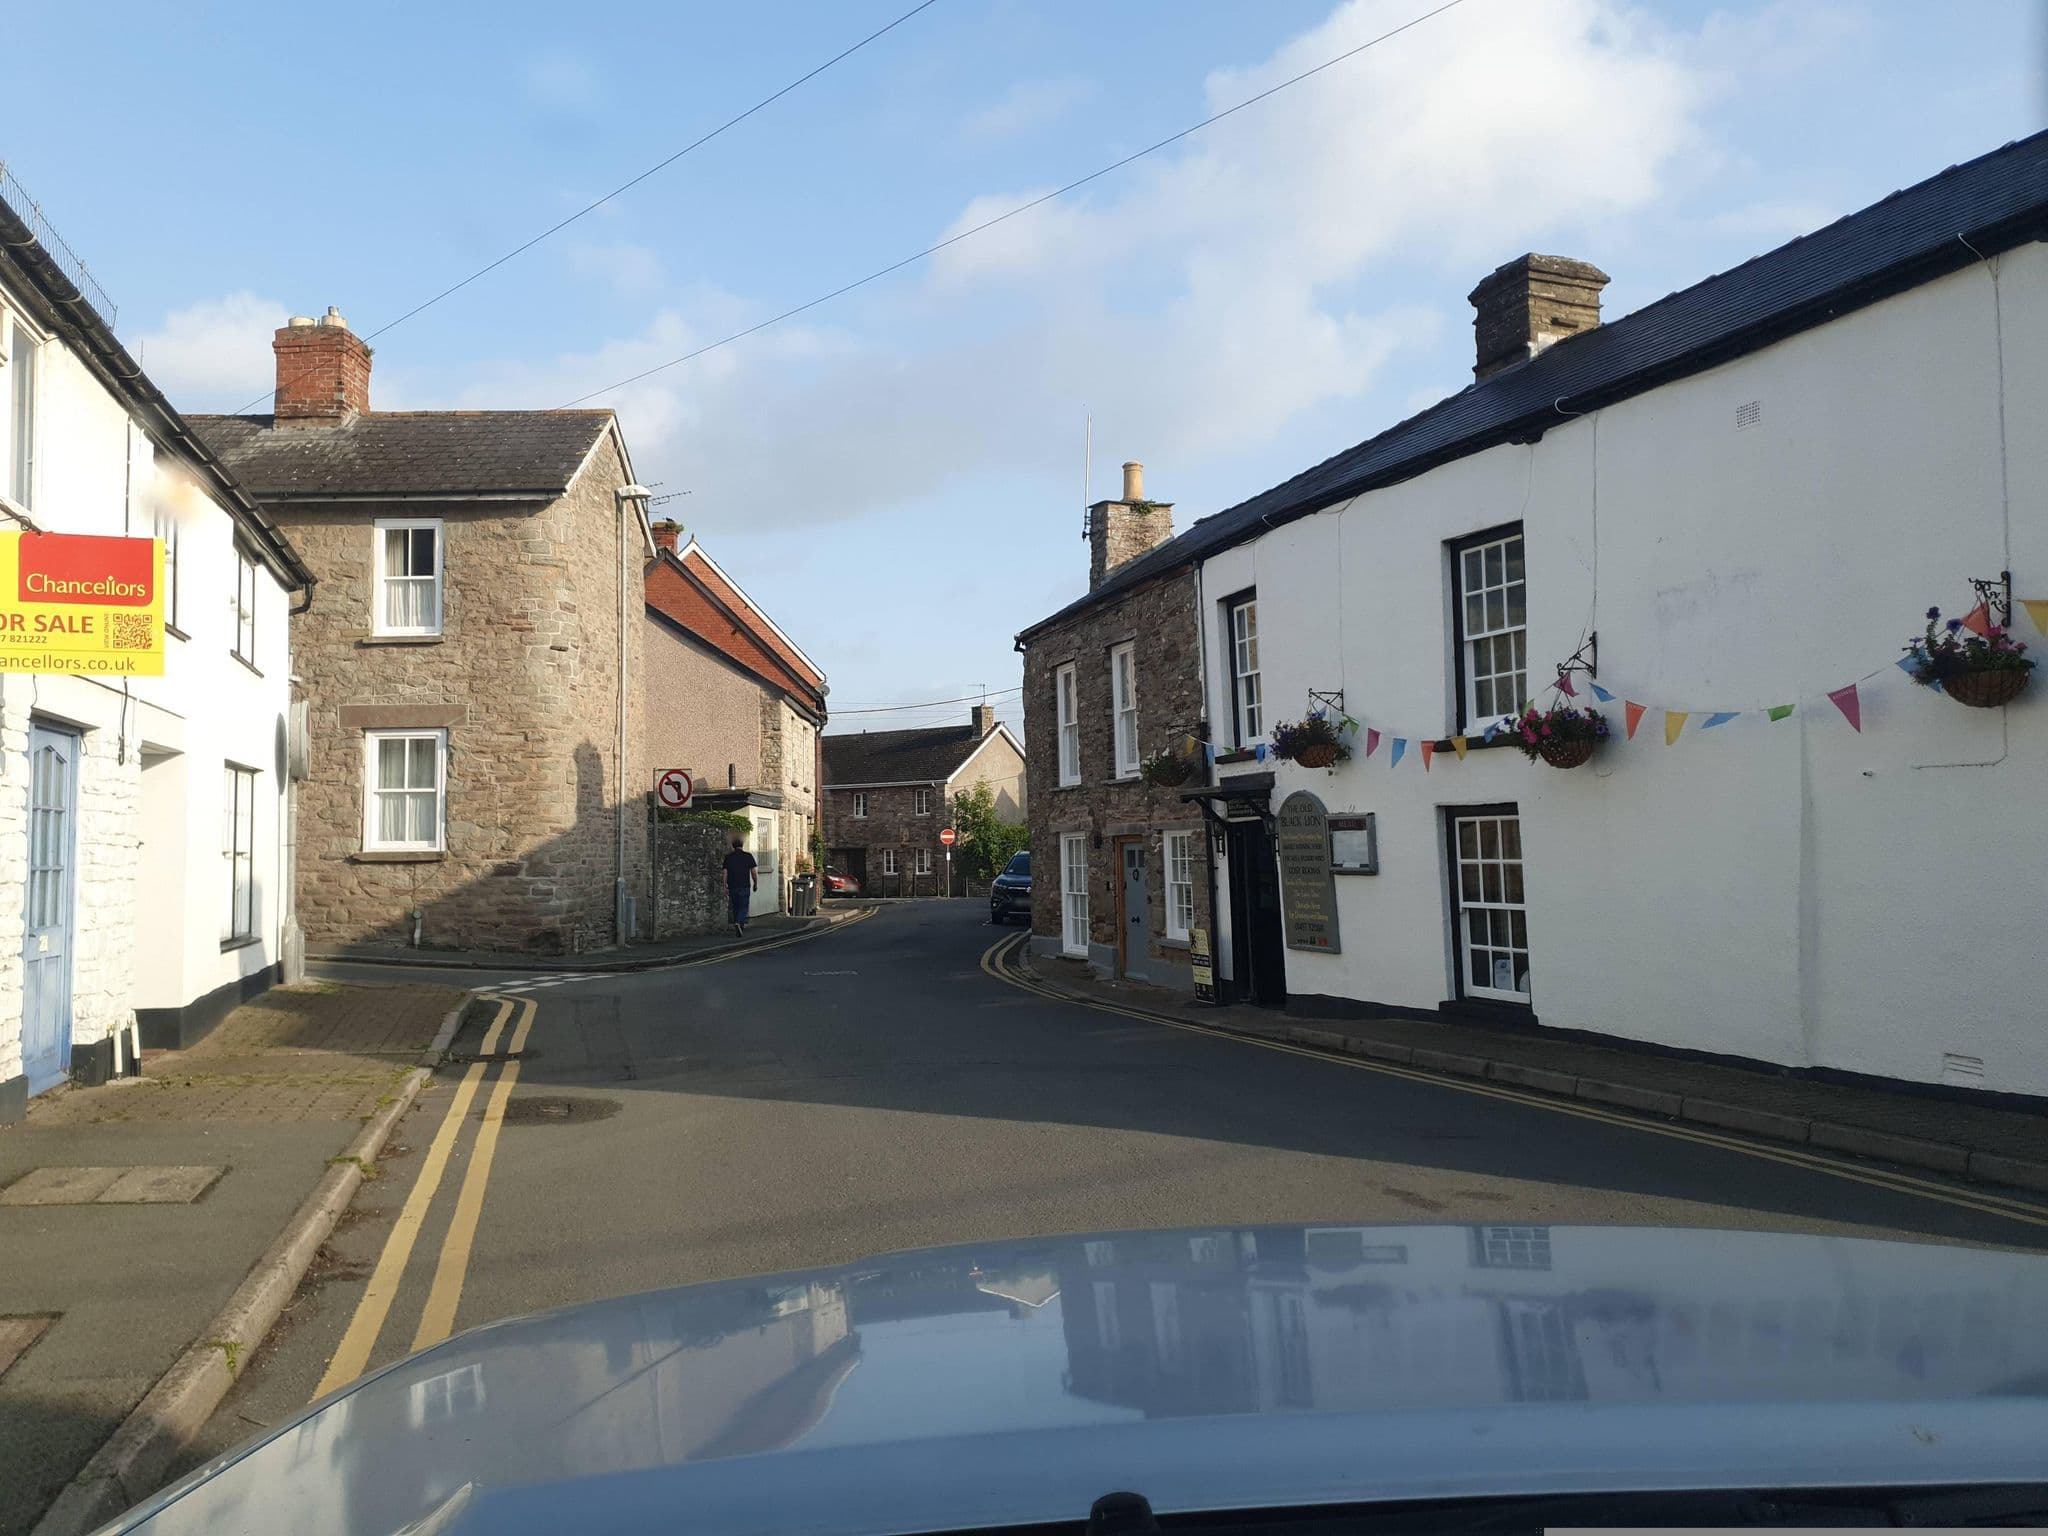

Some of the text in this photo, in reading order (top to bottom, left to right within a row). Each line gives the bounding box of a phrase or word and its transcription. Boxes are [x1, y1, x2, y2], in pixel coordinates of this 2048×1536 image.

[26, 573, 146, 597] Chancellors
[34, 614, 94, 634] SALE
[10, 635, 47, 644] 821222
